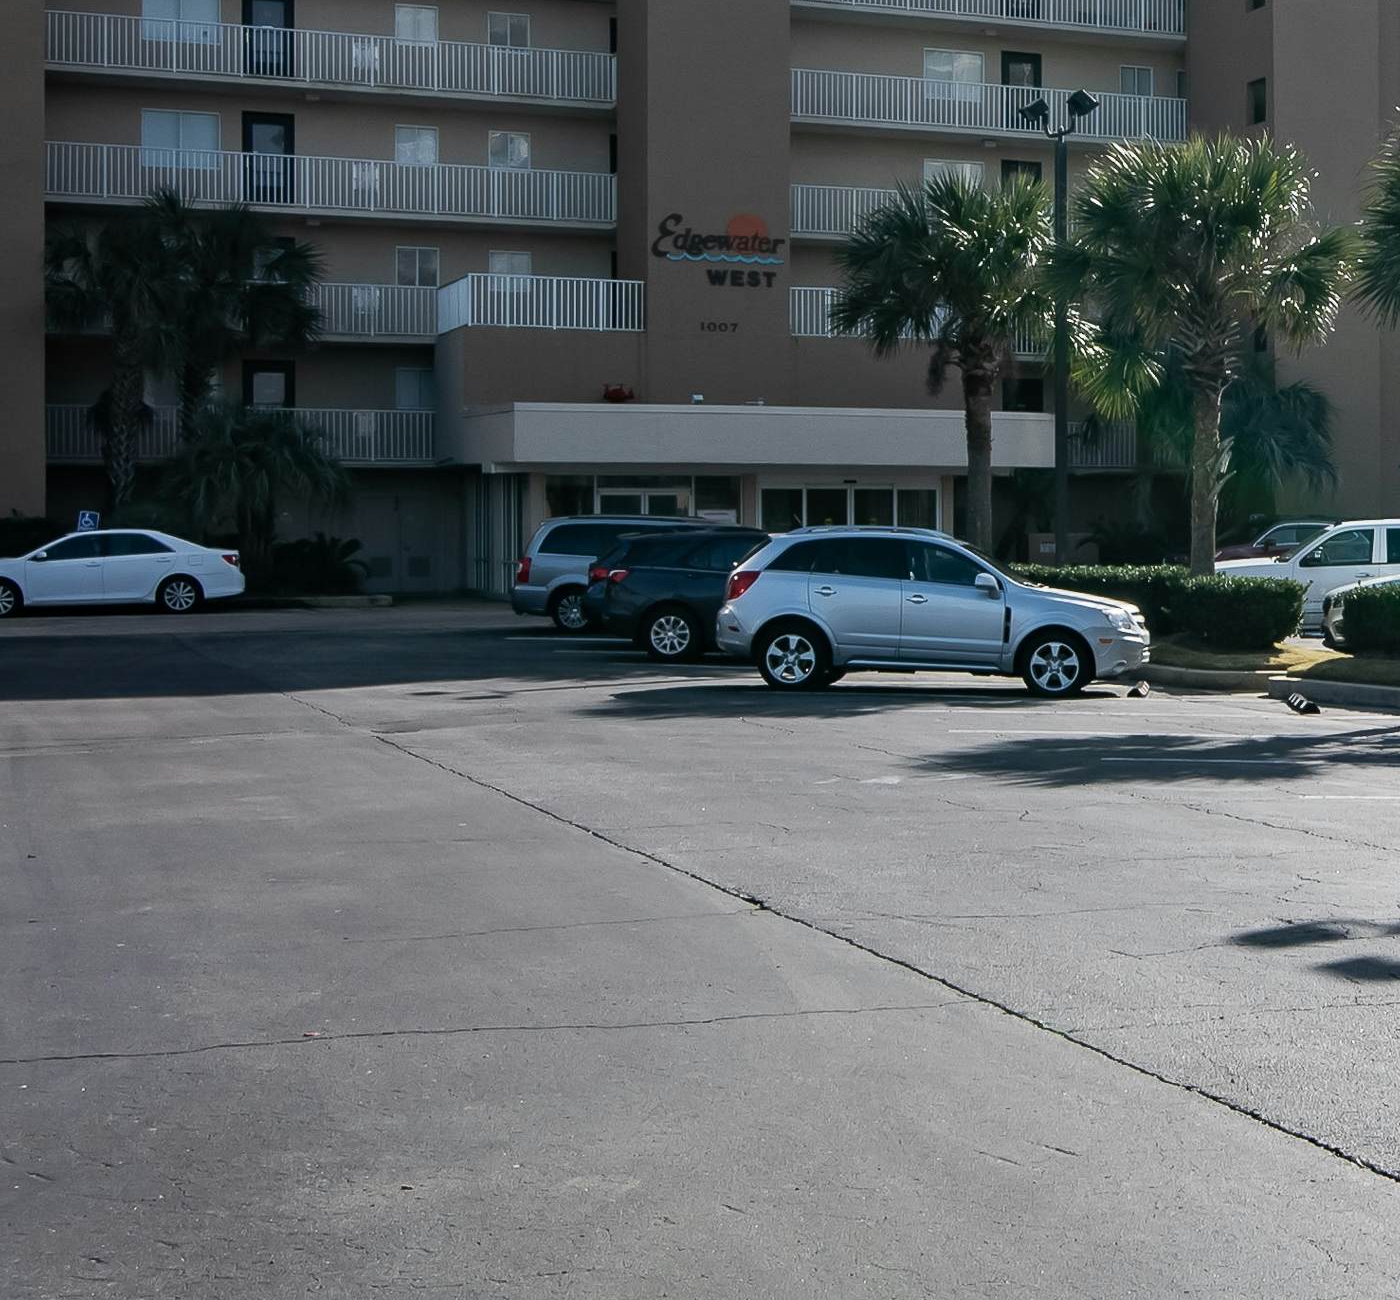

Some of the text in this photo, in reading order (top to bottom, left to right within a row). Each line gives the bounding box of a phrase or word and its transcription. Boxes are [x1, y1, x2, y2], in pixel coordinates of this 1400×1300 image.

[652, 213, 785, 257] Edgewater
[706, 269, 777, 288] WEST
[701, 322, 739, 333] 1007
